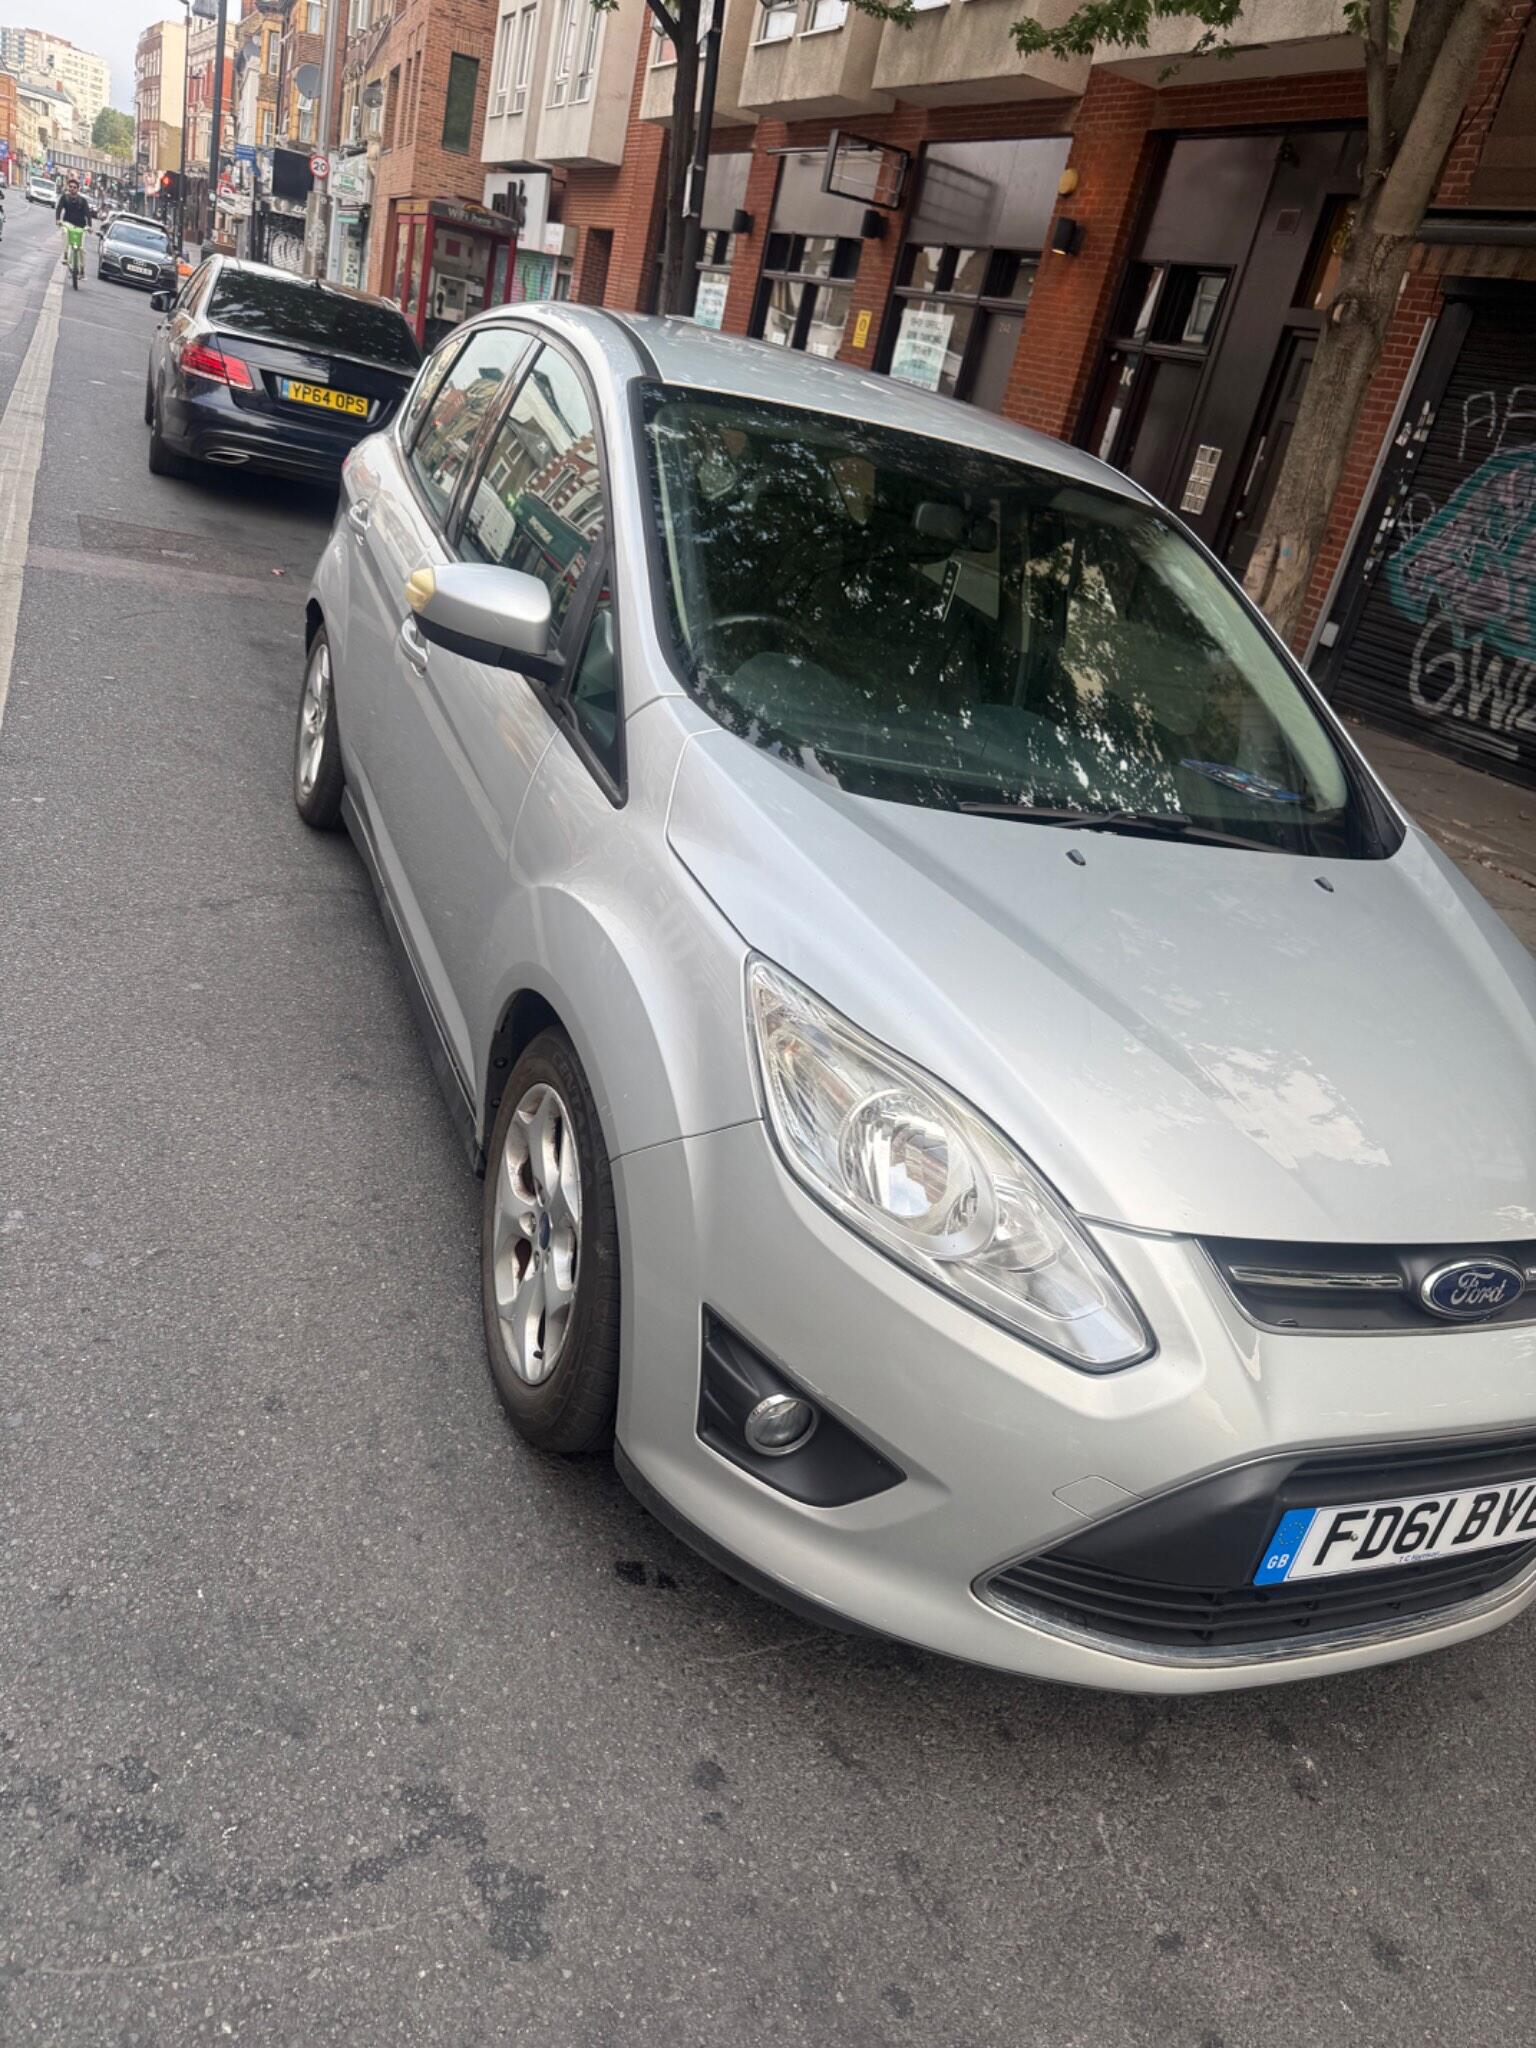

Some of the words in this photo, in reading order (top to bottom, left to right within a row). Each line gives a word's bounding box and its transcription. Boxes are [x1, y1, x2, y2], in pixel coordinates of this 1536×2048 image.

[313, 160, 325, 172] 20
[293, 384, 331, 405] YP64
[335, 394, 365, 413] OPS
[1450, 1272, 1507, 1305] Ford
[1313, 1498, 1458, 1566] FD61
[1267, 1554, 1290, 1569] GB
